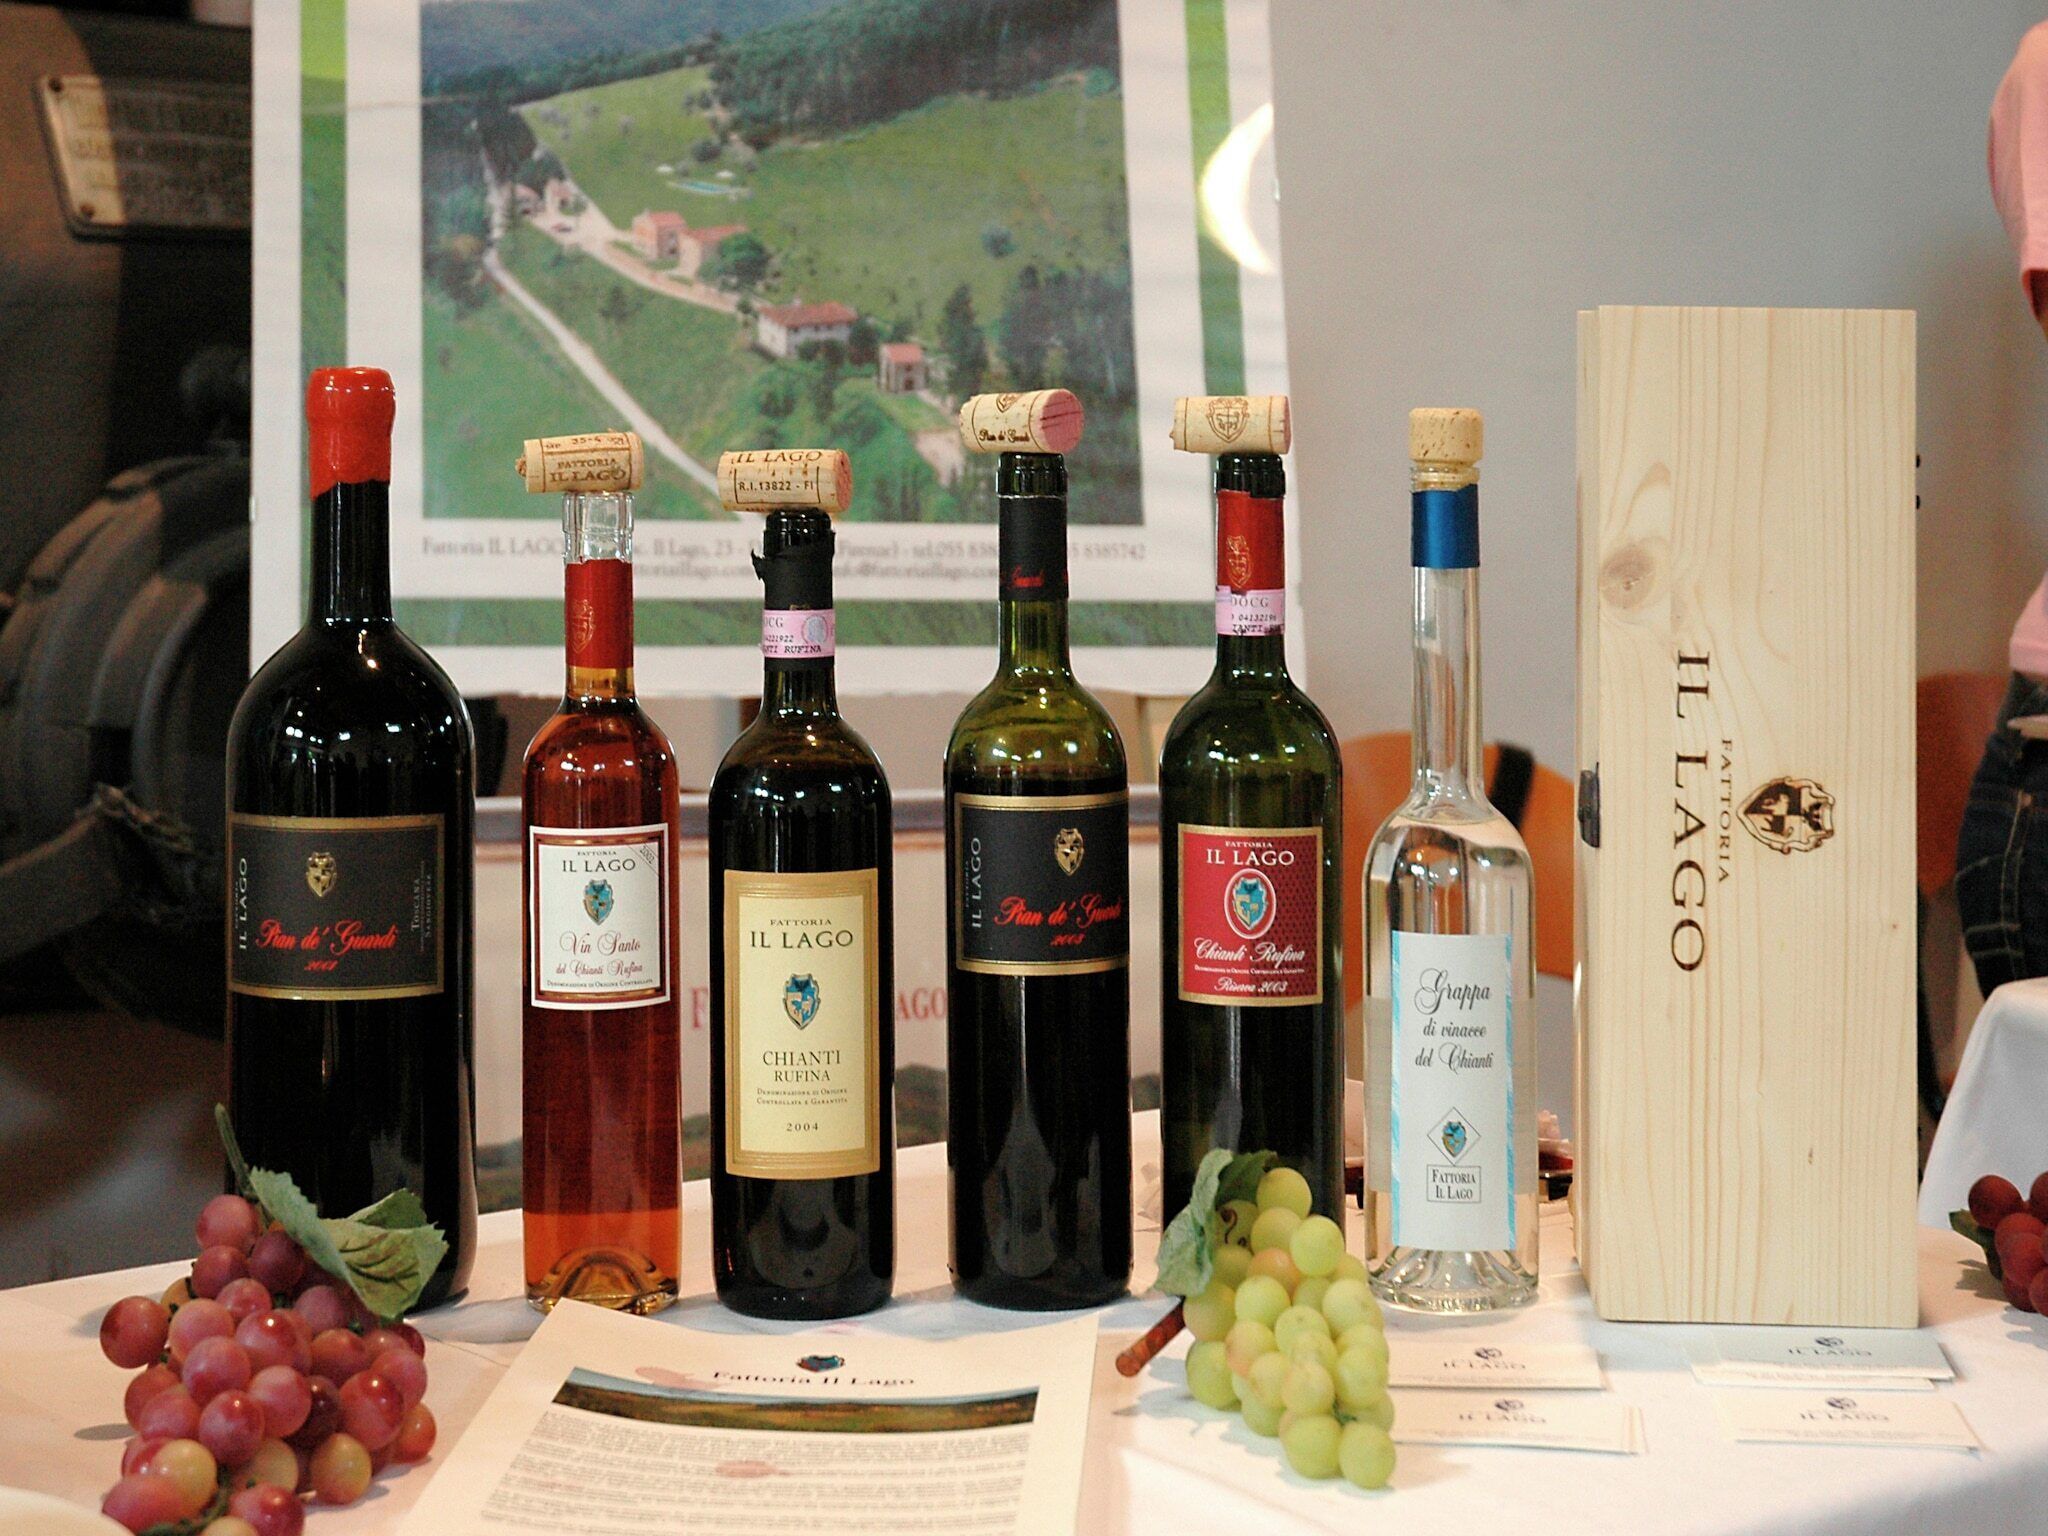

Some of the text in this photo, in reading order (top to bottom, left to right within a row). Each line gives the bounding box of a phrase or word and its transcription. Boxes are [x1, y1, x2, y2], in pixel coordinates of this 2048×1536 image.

[558, 458, 617, 469] FATTORIA
[737, 451, 822, 463] IL LAGO
[551, 469, 626, 482] IL LAGO
[423, 538, 485, 555] Fattoria
[784, 645, 821, 653] RUFINA
[1671, 650, 1710, 971] IL LAGO
[1718, 738, 1733, 883] FATTORIA
[562, 858, 636, 873] IL LAGO
[1206, 849, 1295, 866] IL LAGO
[970, 837, 982, 928] IL LAGO
[239, 858, 247, 950] IL LAGO
[770, 918, 833, 926] FATTORIA
[560, 930, 641, 956] Vin Santo
[751, 930, 854, 949] IL LAGO
[1194, 937, 1306, 969] Chianti Rufina
[556, 959, 643, 978] del Chianti Rufina
[1414, 967, 1491, 1015] Grappa
[896, 986, 948, 1021] AGO
[1423, 1017, 1487, 1038] di vinacce
[763, 1050, 841, 1066] CHIANTI
[1415, 1042, 1495, 1075] del Chianti
[774, 1069, 831, 1082] RUFINA
[786, 1122, 819, 1132] 2004
[1432, 1169, 1476, 1185] FATTORIA
[1447, 1184, 1473, 1200] LAGO
[714, 1371, 810, 1384] Fattoria
[851, 1377, 914, 1386] Lago
